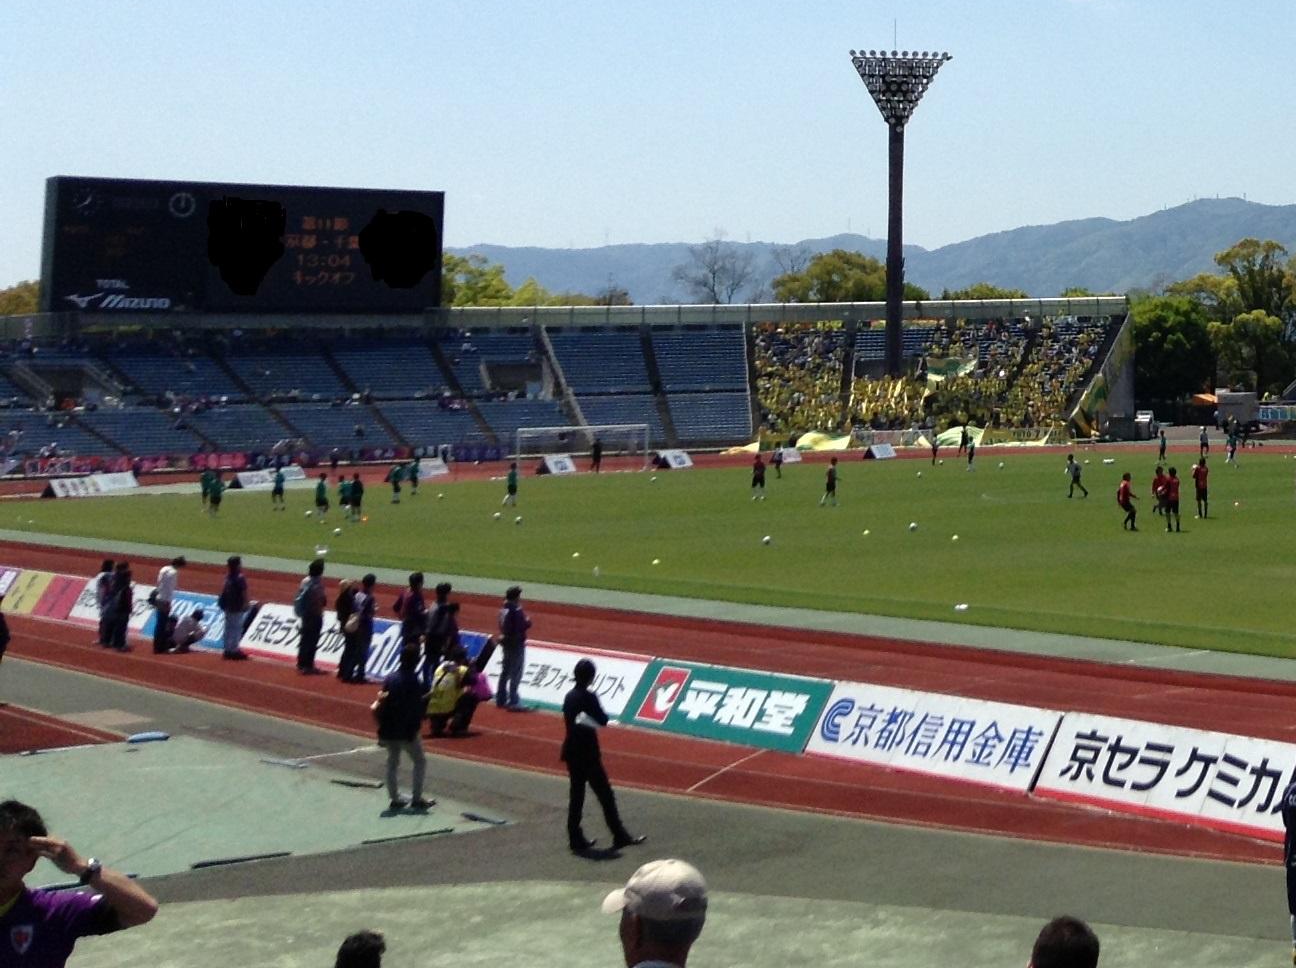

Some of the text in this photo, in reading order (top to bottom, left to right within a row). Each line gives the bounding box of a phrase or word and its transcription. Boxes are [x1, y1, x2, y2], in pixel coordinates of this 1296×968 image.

[678, 679, 811, 736] 平和堂
[843, 703, 1044, 774] 京都信用金庫
